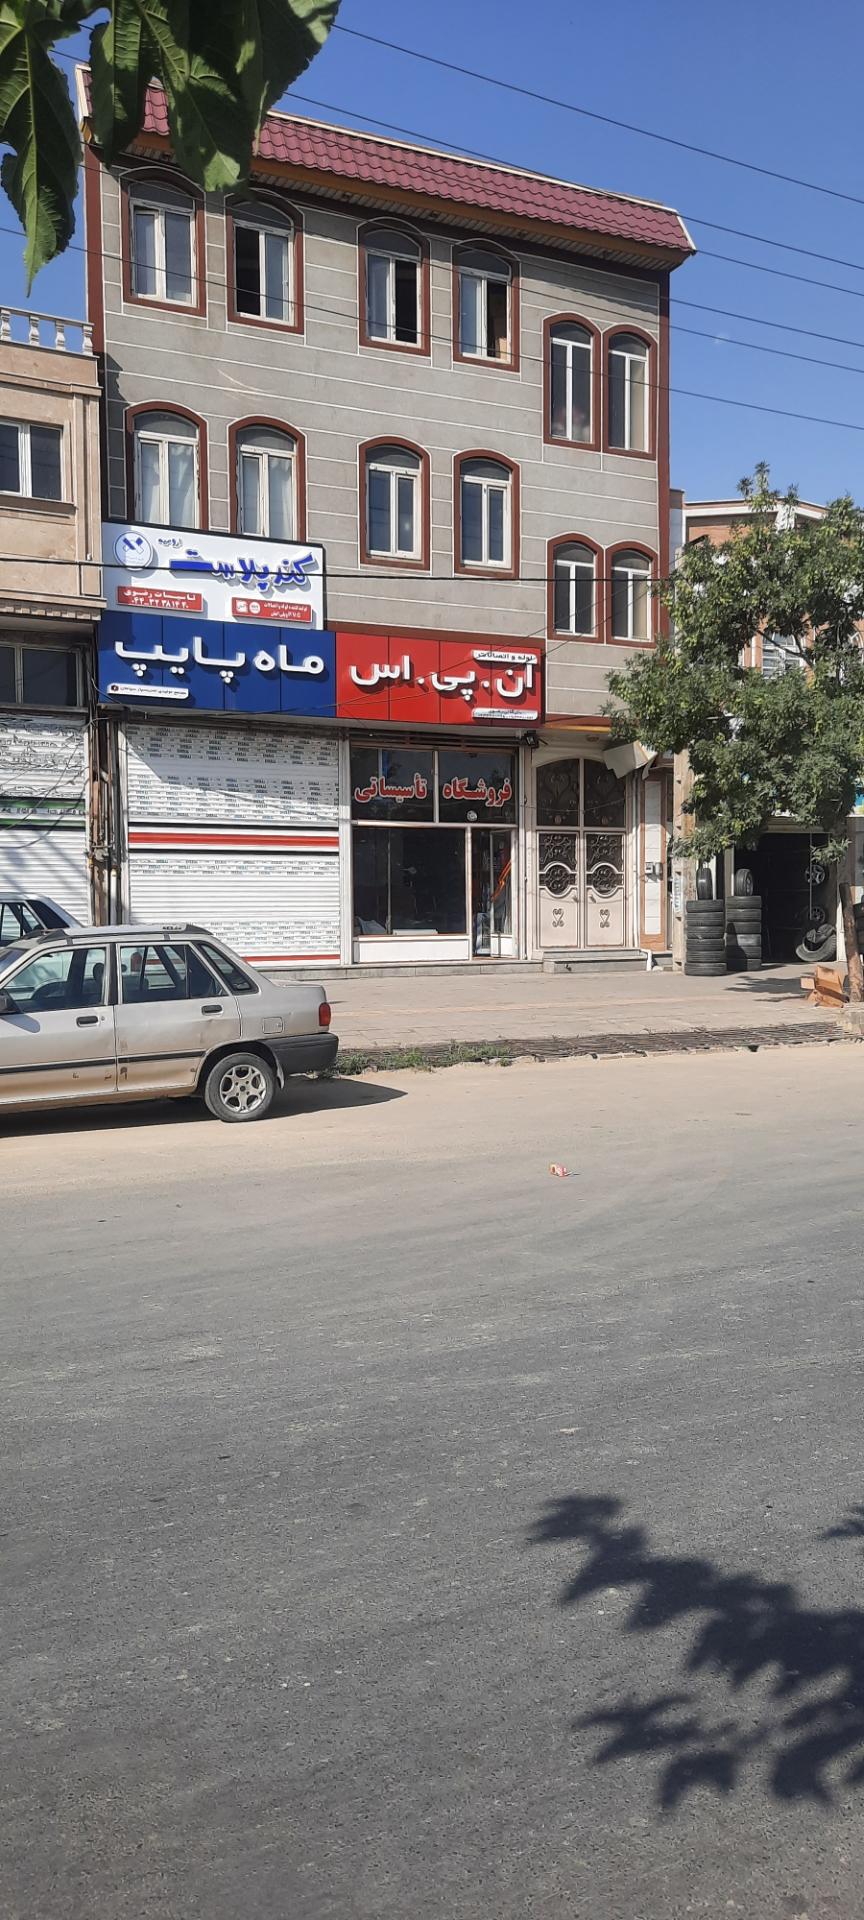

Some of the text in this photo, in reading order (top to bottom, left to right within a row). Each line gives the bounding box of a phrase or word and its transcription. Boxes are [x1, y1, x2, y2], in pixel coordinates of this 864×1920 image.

[114, 636, 325, 684] ماه پایپ
[442, 776, 513, 807] فروشگاه
